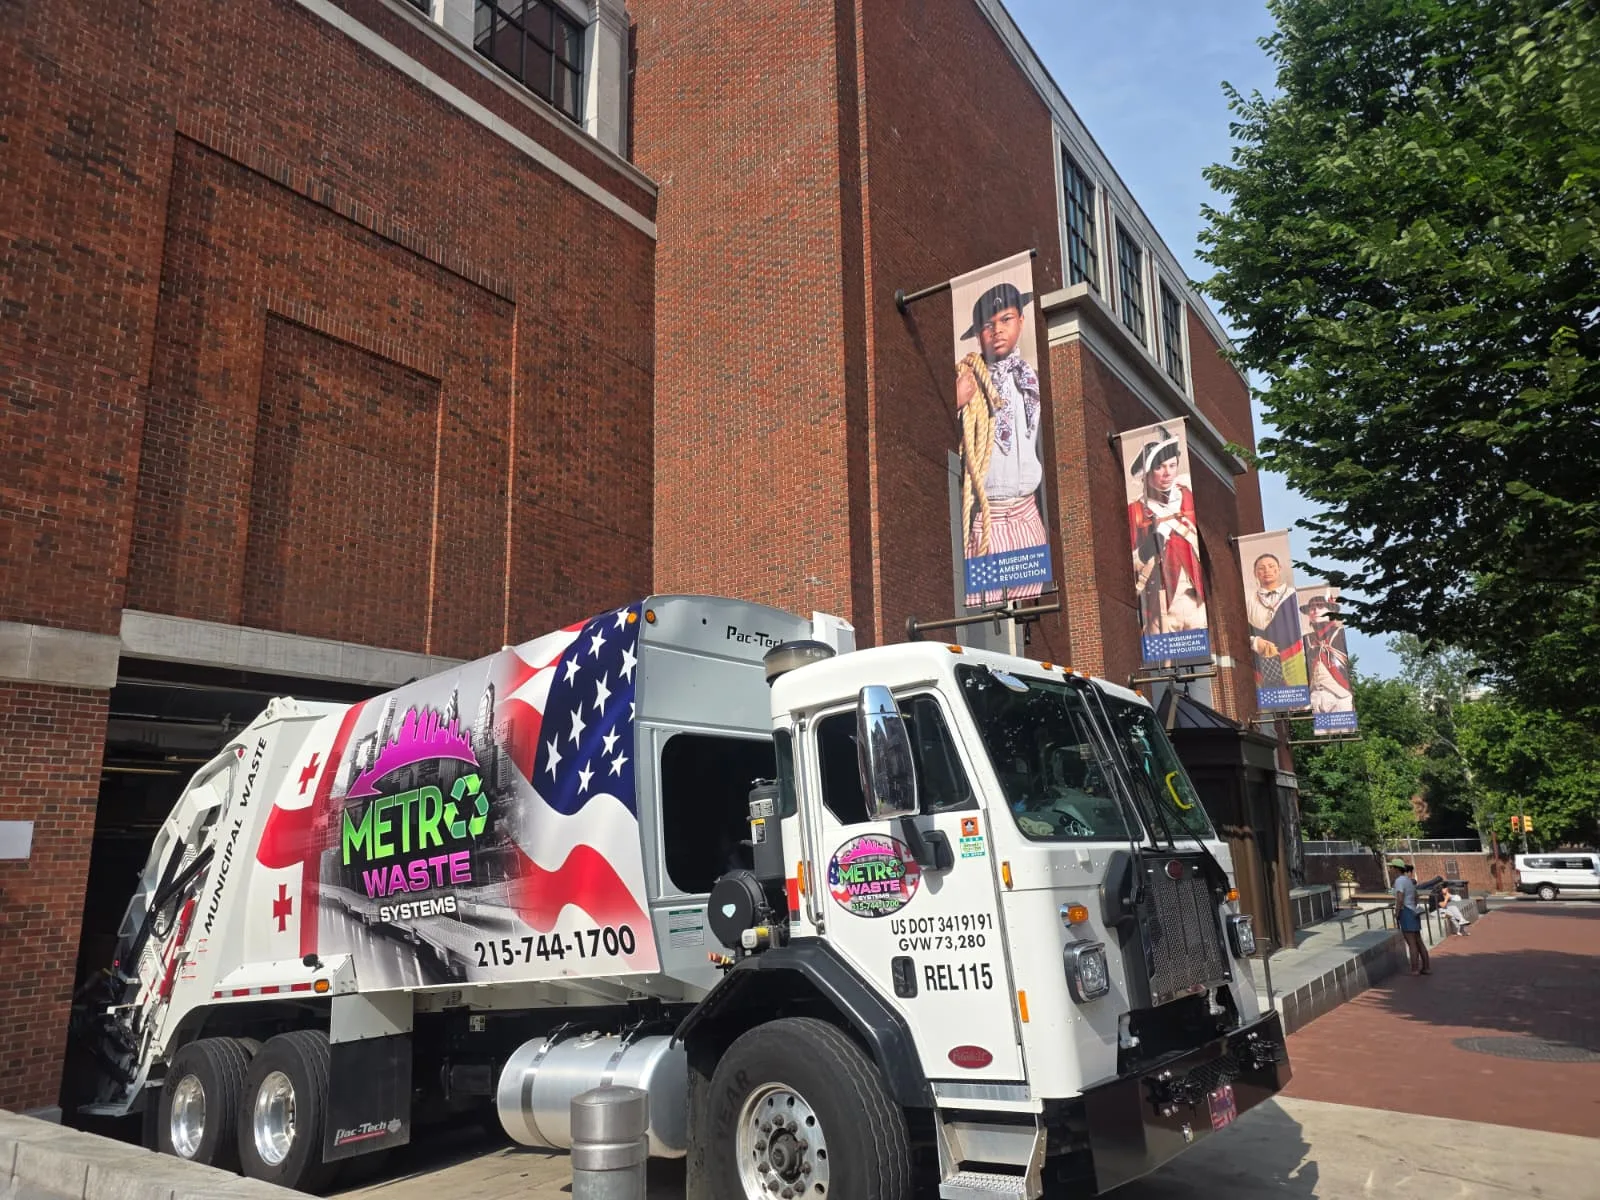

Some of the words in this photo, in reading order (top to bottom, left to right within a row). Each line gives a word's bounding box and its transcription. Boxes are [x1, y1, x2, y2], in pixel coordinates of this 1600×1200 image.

[999, 554, 1029, 566] MUSEUM
[999, 560, 1039, 574] AMERICAN
[999, 568, 1046, 581] REVOLUTION
[204, 818, 243, 934] MUNICIPAL
[239, 737, 268, 807] WASTE
[362, 850, 472, 898] WASTE
[847, 880, 901, 895] WASTE
[380, 896, 457, 923] SYSTEMS
[891, 919, 907, 935] US
[908, 917, 935, 934] DOT
[937, 913, 993, 932] 3419191
[474, 925, 636, 968] 215-744-1700
[898, 937, 932, 951] GVW
[934, 934, 986, 951] 73,280
[923, 962, 994, 991] REL115
